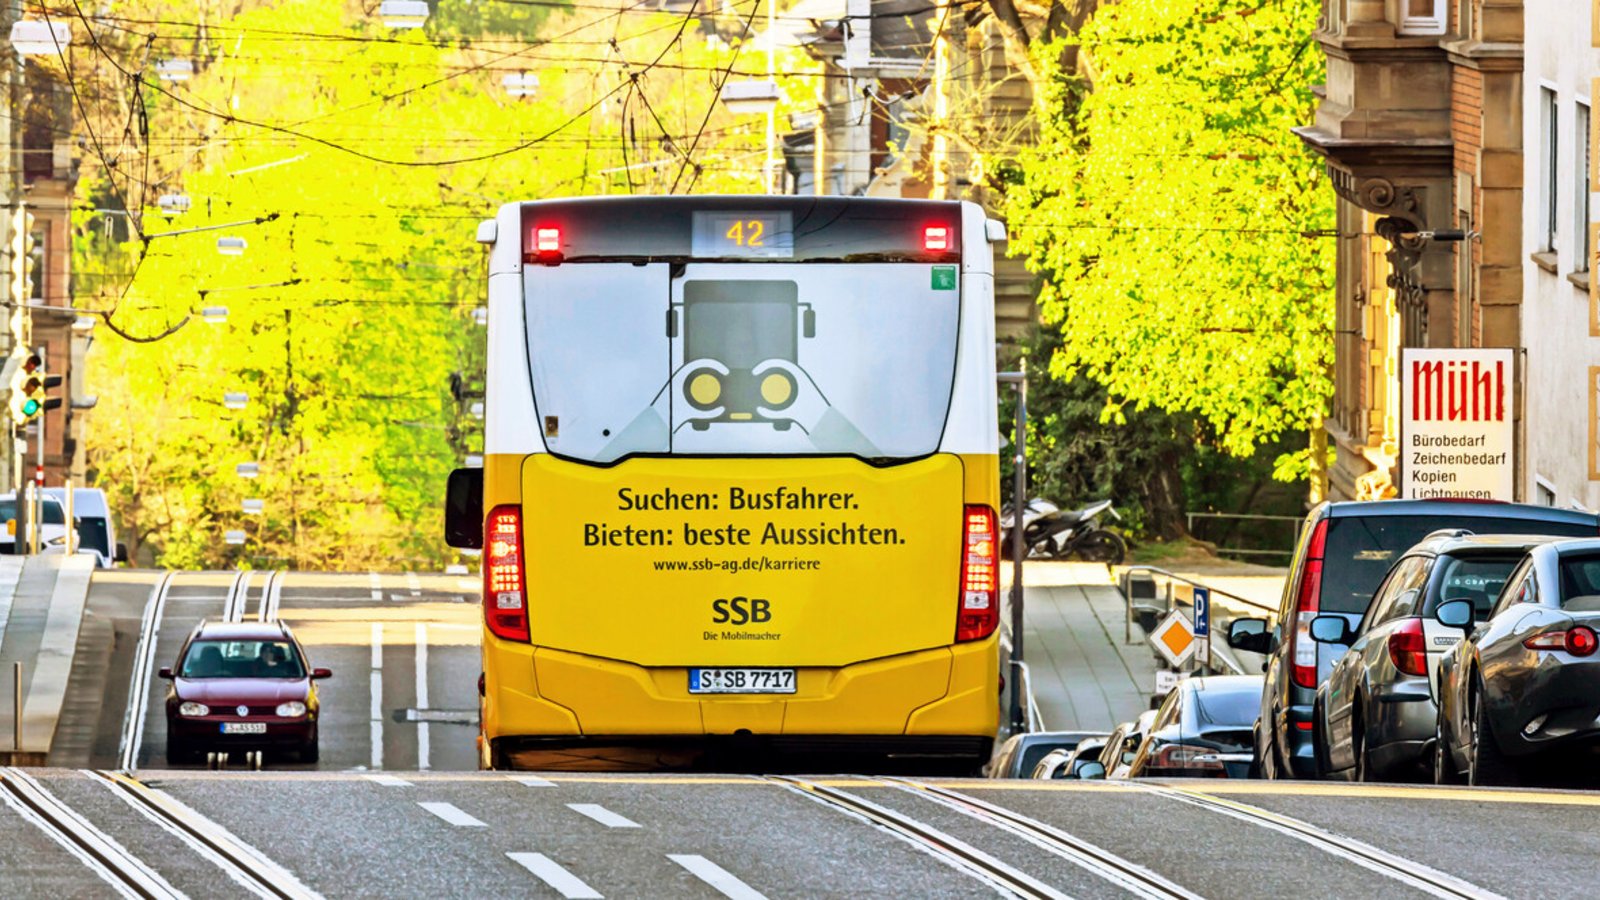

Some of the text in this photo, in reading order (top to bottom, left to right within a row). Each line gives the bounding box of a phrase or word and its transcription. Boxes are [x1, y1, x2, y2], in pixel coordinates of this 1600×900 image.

[726, 220, 763, 246] 42
[1412, 434, 1486, 447] Bürobedarf
[1412, 452, 1507, 465] Zeichenbedarf
[1412, 470, 1457, 484] Kopien
[617, 486, 859, 510] Suchen: Busfahrer.
[584, 522, 906, 547] Bieten: beste Aussichten.
[653, 556, 821, 574] www.ssb-ag.de/karriere
[712, 596, 772, 625] SSB
[1195, 593, 1205, 629] P
[703, 631, 781, 641] Die Mobilmacher
[750, 671, 793, 688] 7717
